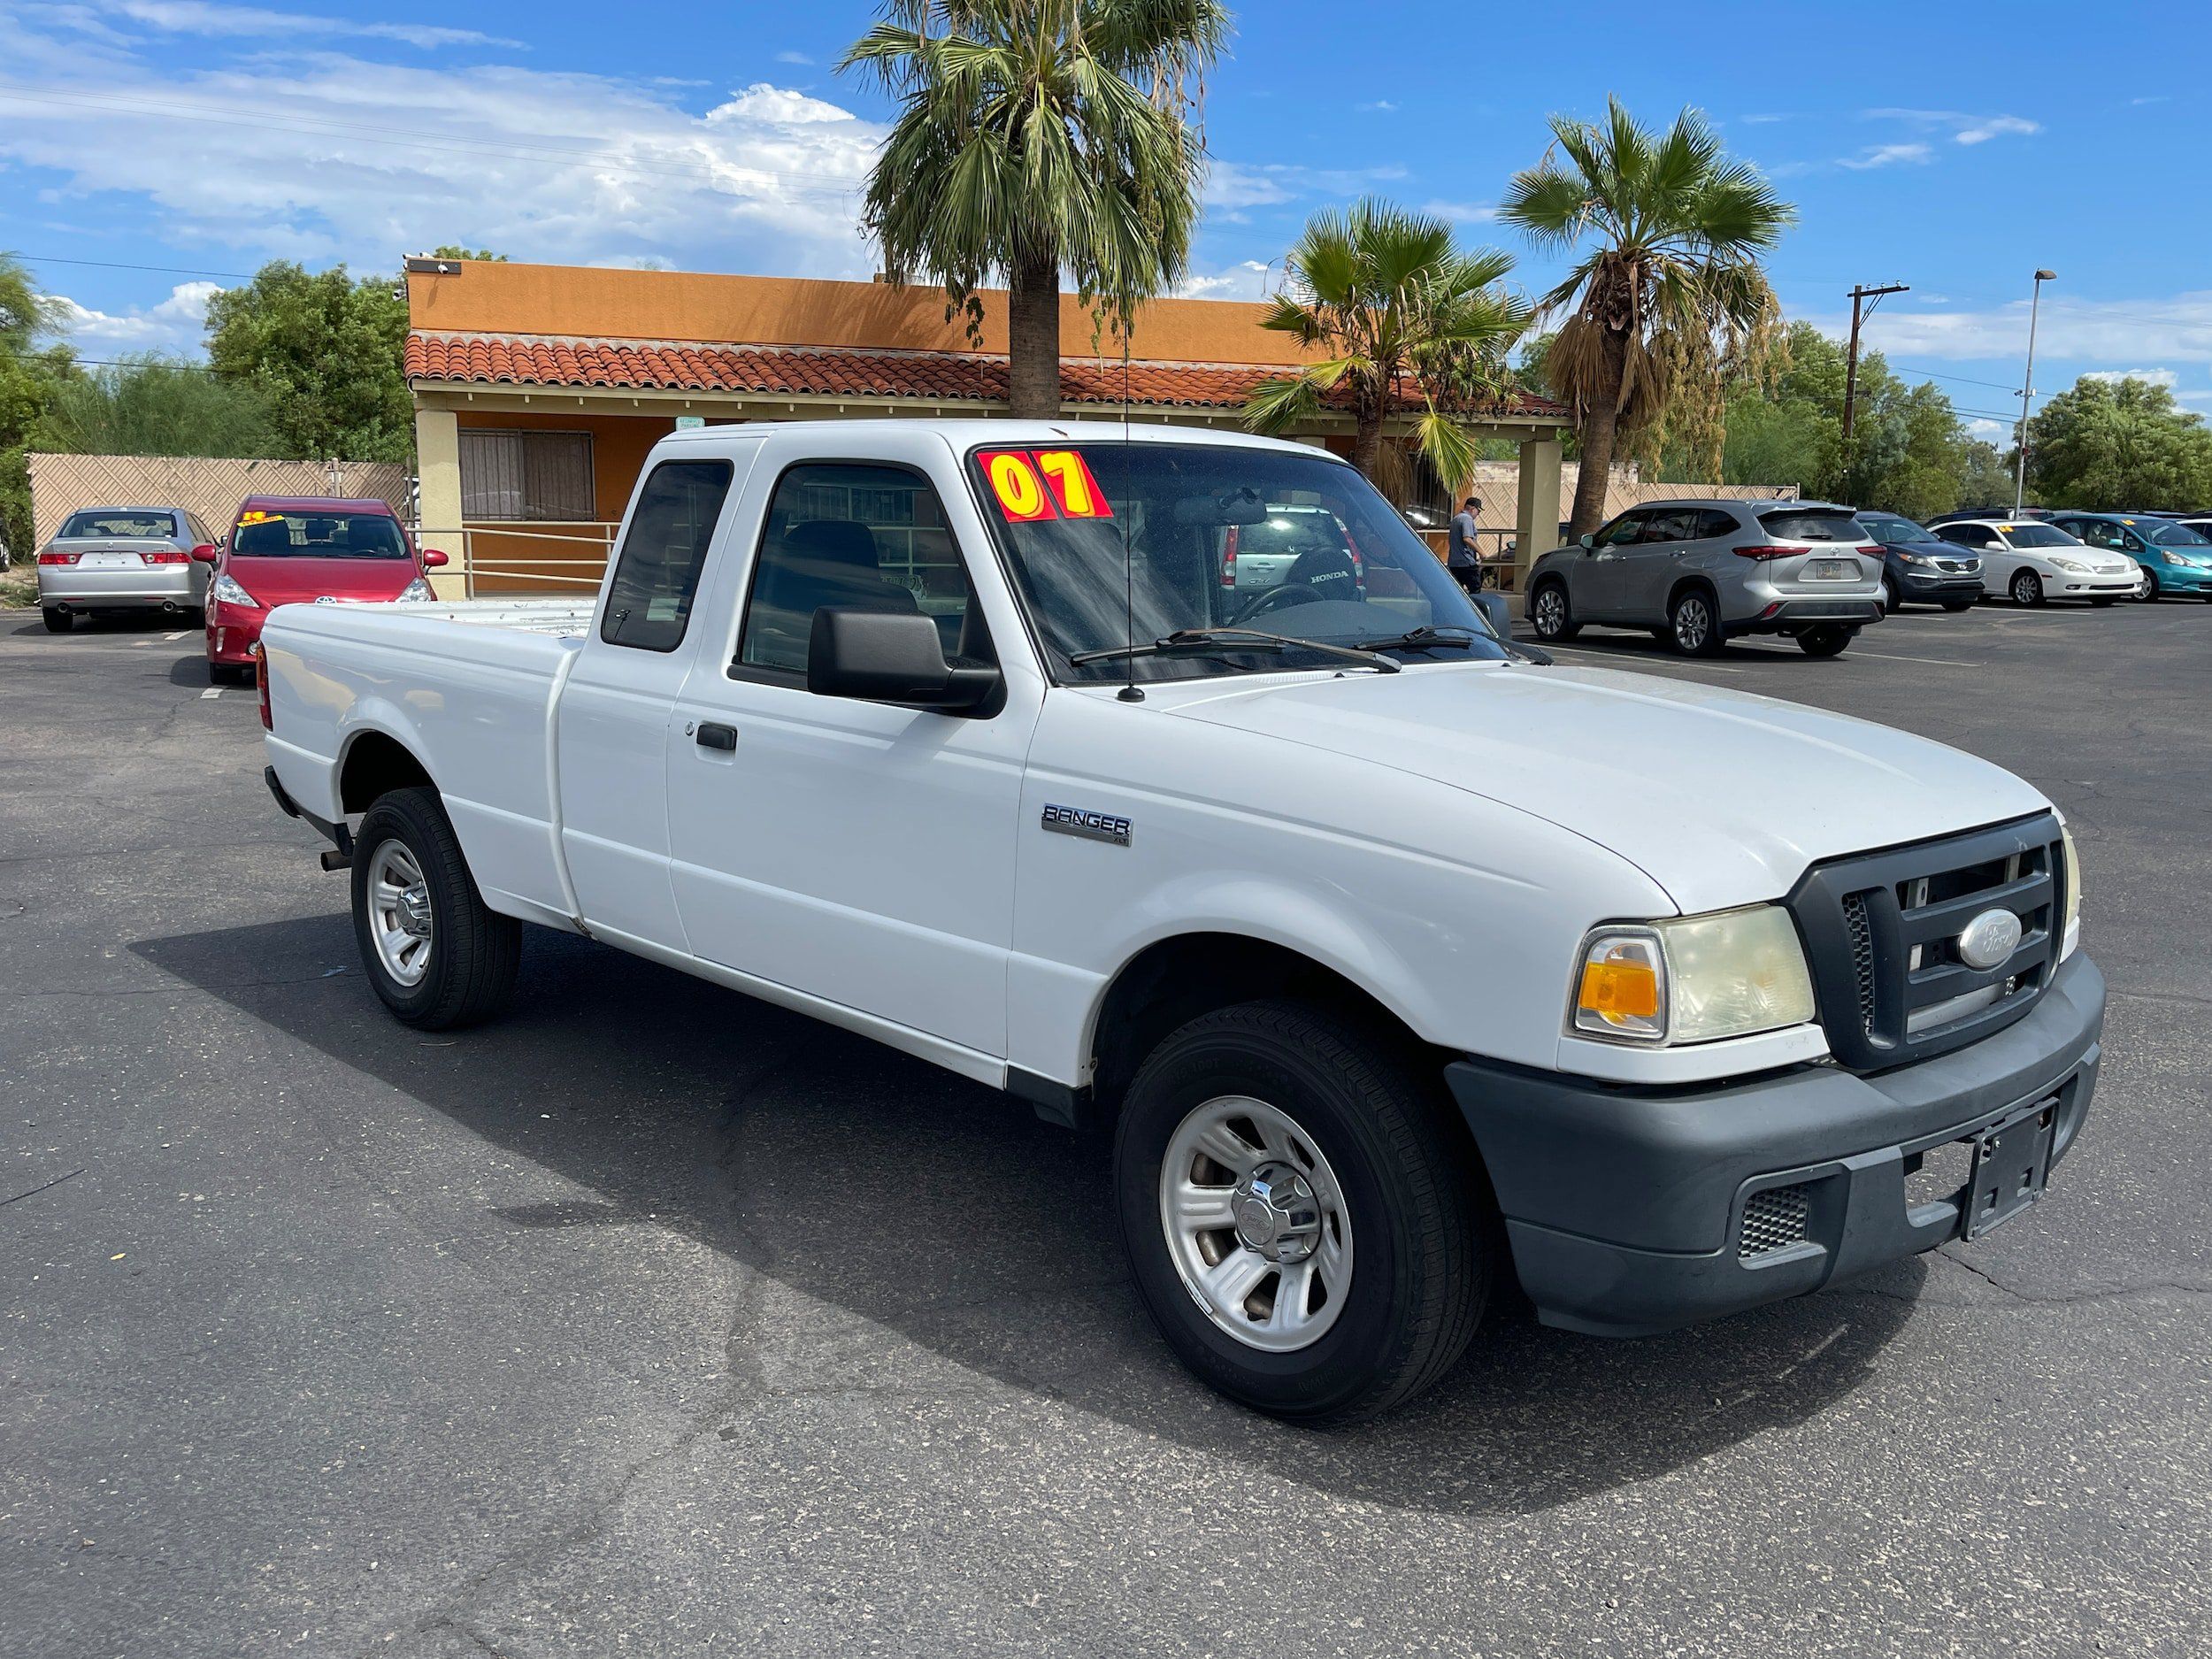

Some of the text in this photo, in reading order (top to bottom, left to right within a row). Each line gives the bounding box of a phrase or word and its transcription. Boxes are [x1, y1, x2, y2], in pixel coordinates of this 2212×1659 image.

[990, 451, 1095, 518] 07
[1310, 570, 1349, 584] HONDA
[1042, 804, 1131, 836] RANGER
[1982, 920, 2015, 953] Ford
